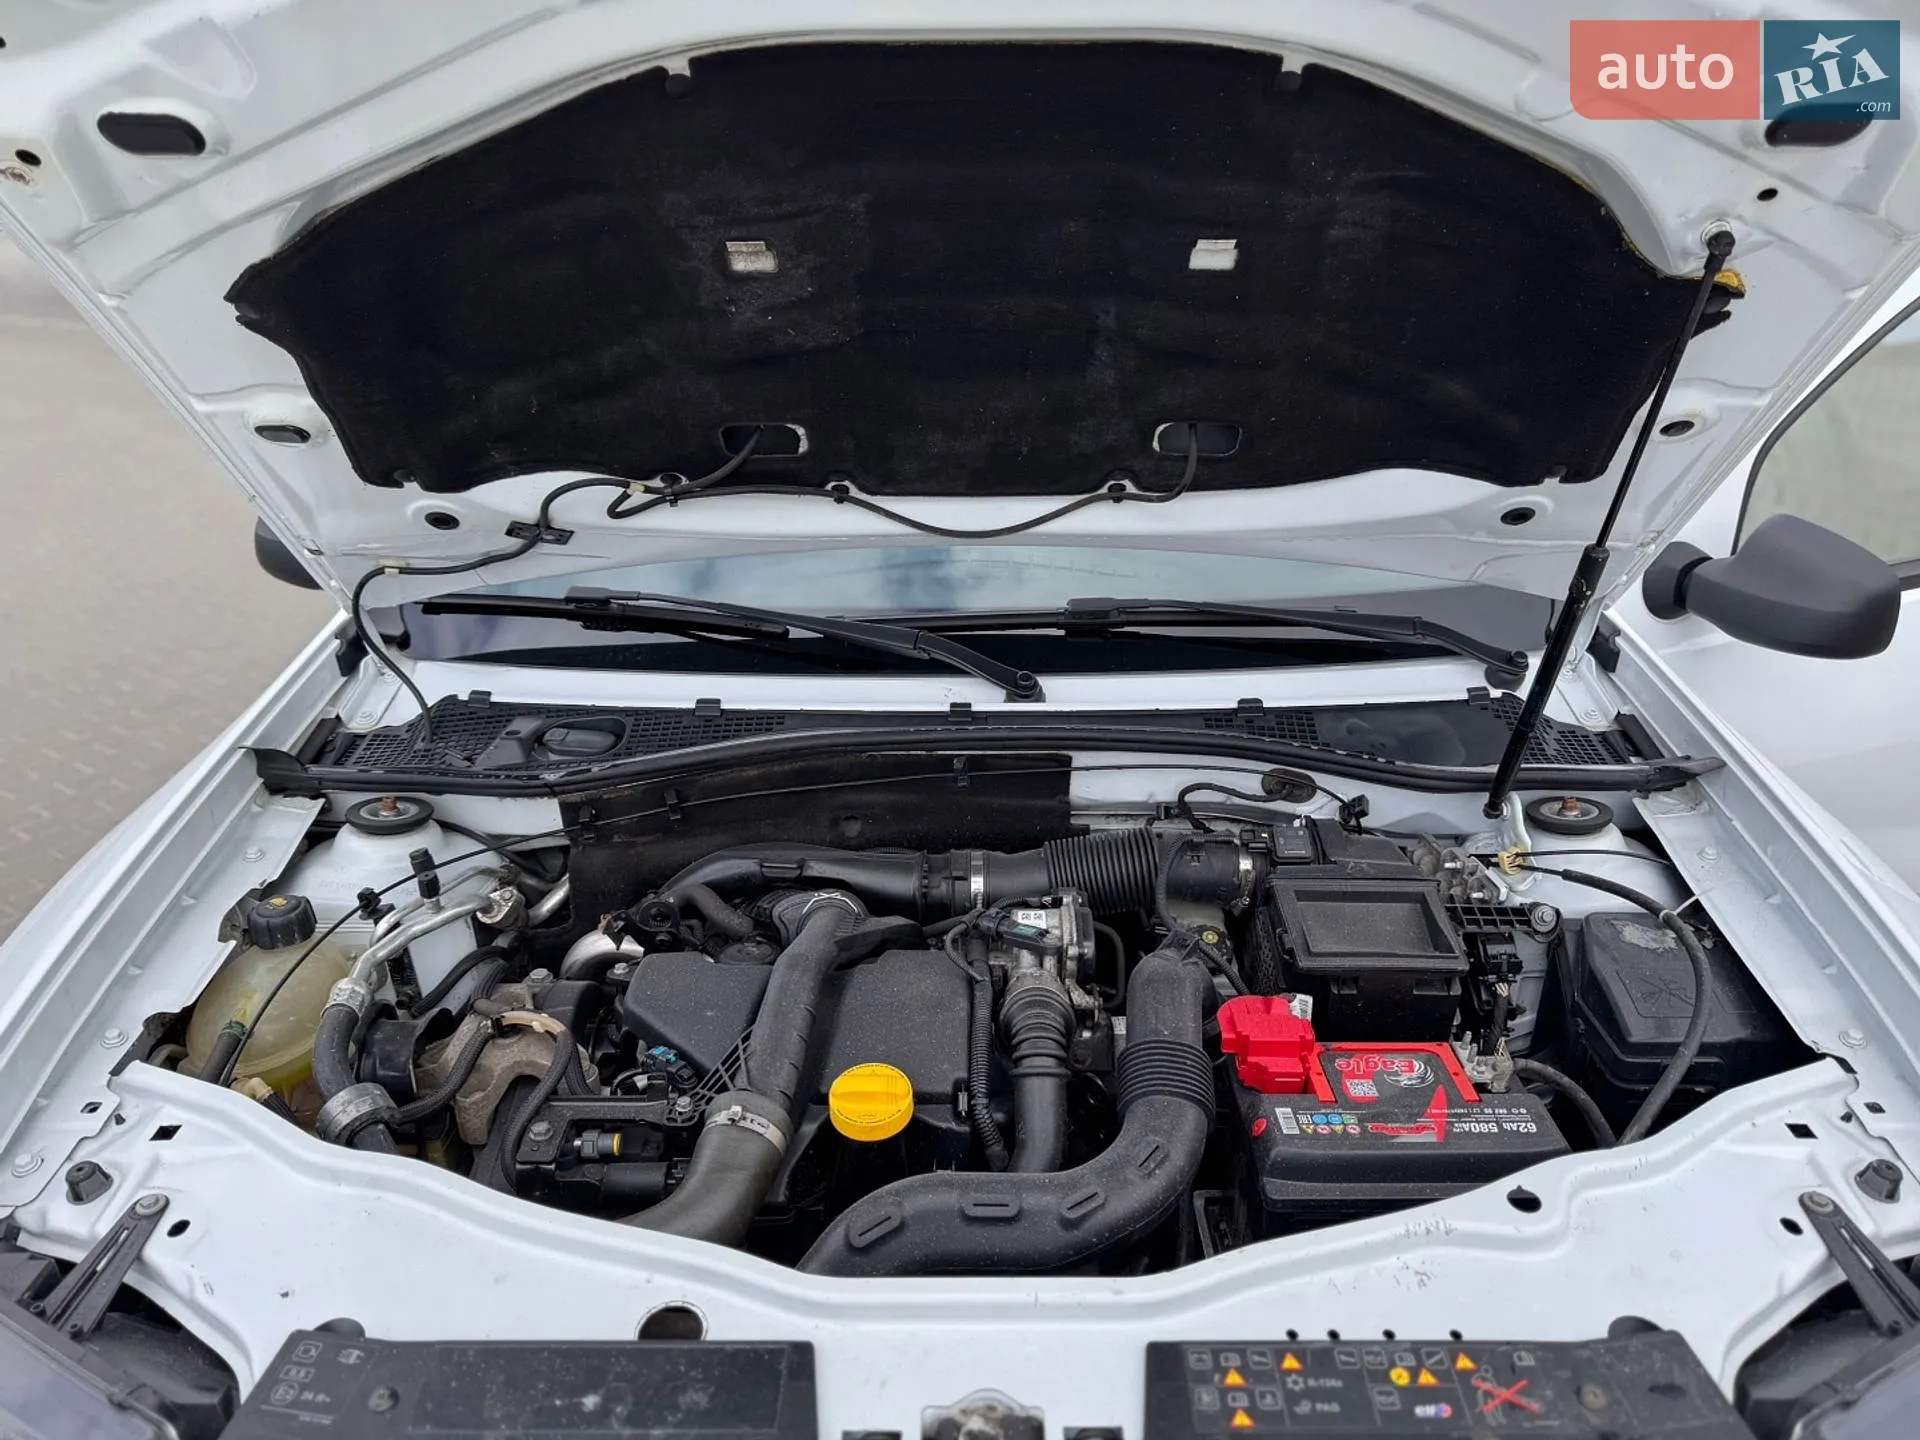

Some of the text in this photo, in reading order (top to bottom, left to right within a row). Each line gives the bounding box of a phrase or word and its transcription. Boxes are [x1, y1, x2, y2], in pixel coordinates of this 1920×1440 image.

[1335, 1055, 1416, 1075] Eagle
[1502, 1122, 1537, 1133] 62Ah
[1414, 1403, 1436, 1417] elf
